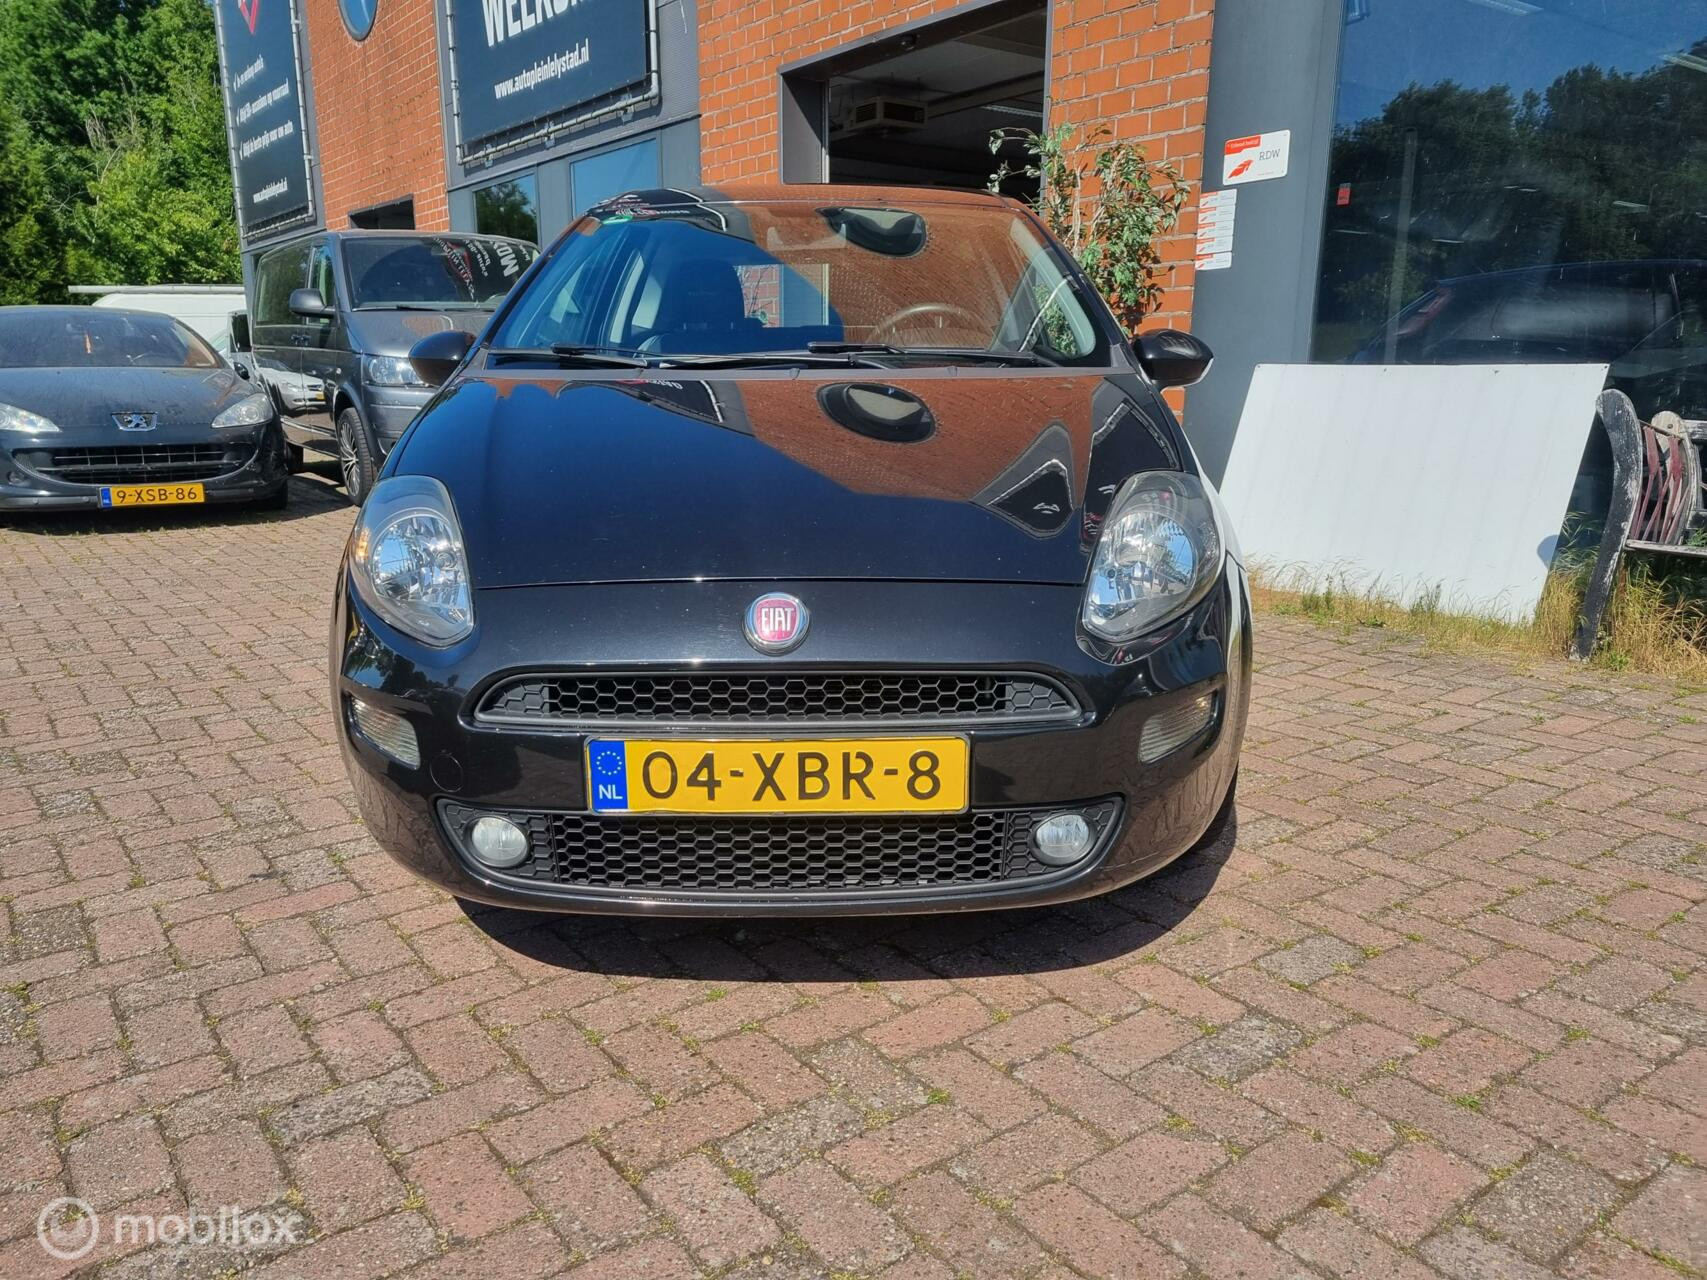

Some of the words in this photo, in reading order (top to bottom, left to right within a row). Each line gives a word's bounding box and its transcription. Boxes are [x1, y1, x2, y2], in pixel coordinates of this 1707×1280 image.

[494, 38, 589, 99] www.autopleinlelystad.nl
[1259, 148, 1281, 161] RDW
[116, 487, 198, 504] 9-XSB-86
[761, 607, 795, 633] FIAT
[599, 784, 623, 800] NL
[642, 750, 942, 801] 04-XBR-8
